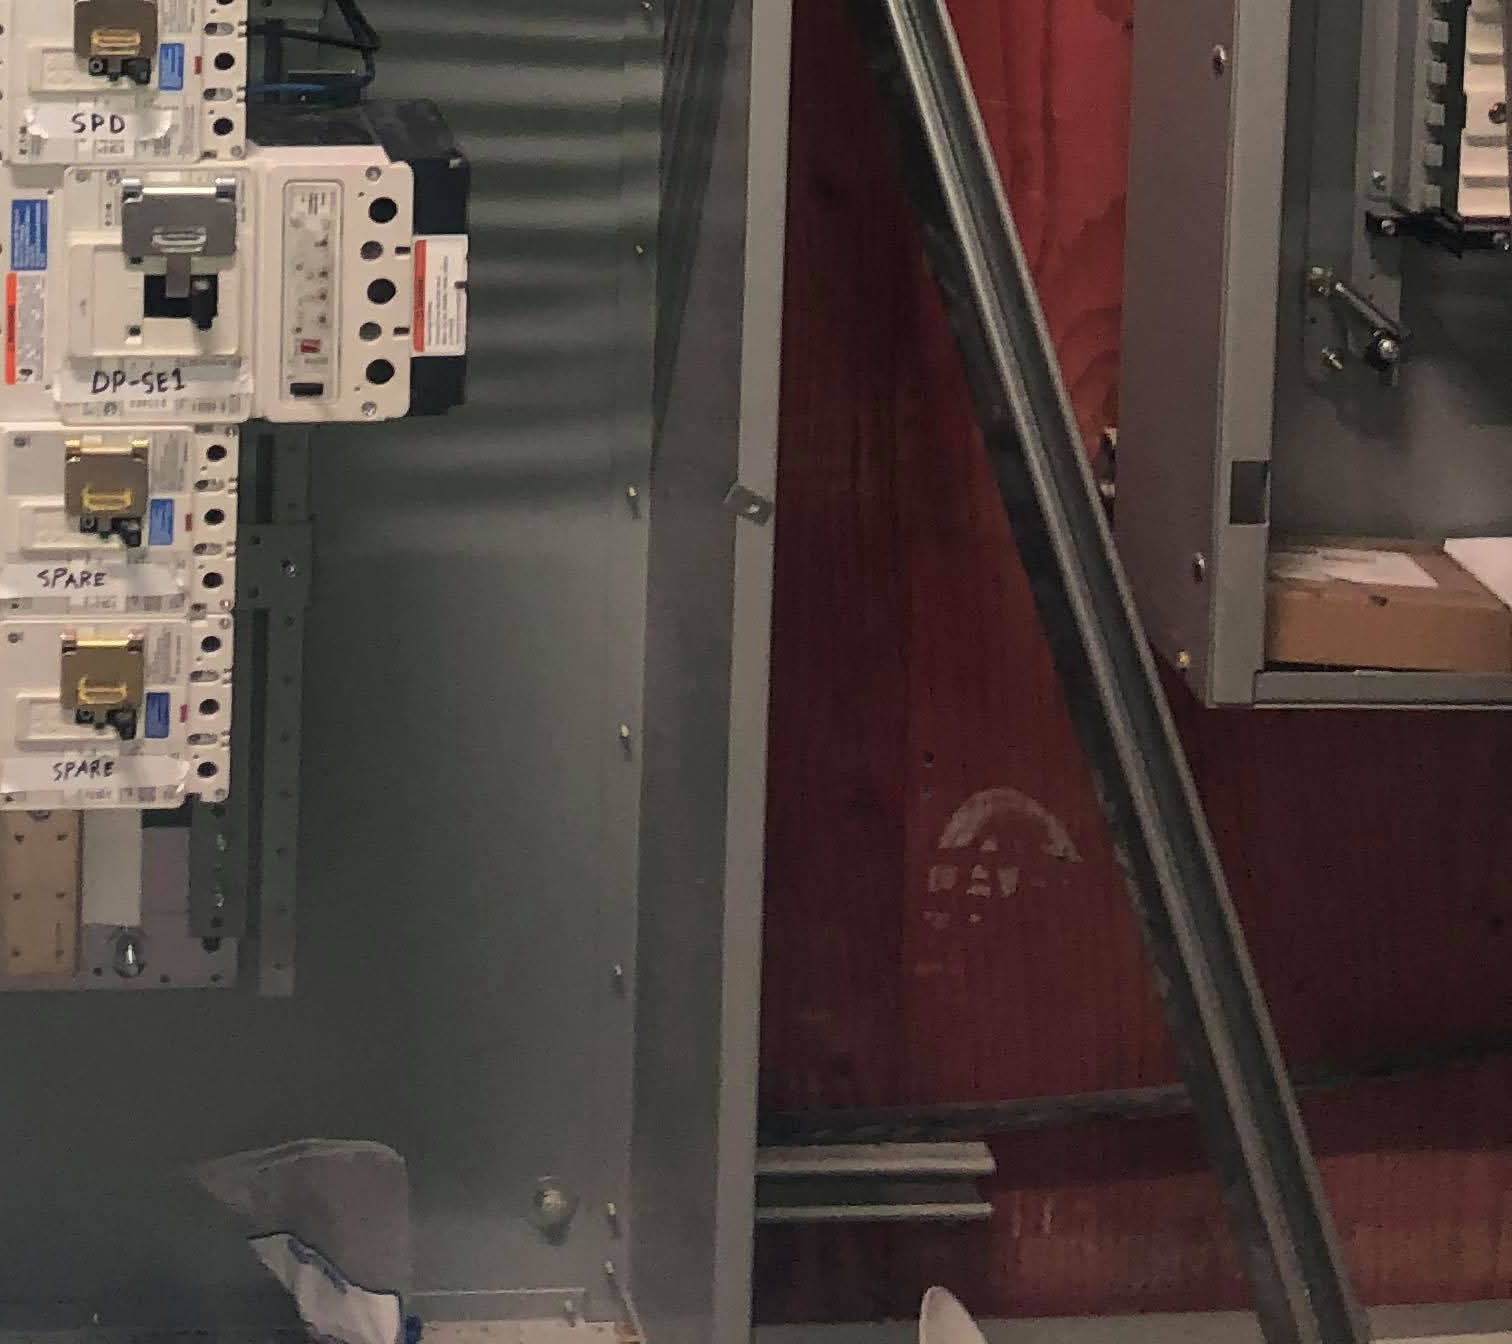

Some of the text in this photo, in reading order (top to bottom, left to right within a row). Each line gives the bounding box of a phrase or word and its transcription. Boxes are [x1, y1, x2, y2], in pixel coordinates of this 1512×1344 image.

[71, 113, 125, 134] SPD
[91, 368, 185, 395] DP-SE1
[37, 567, 106, 589] SPARE
[52, 760, 115, 782] SPARE
